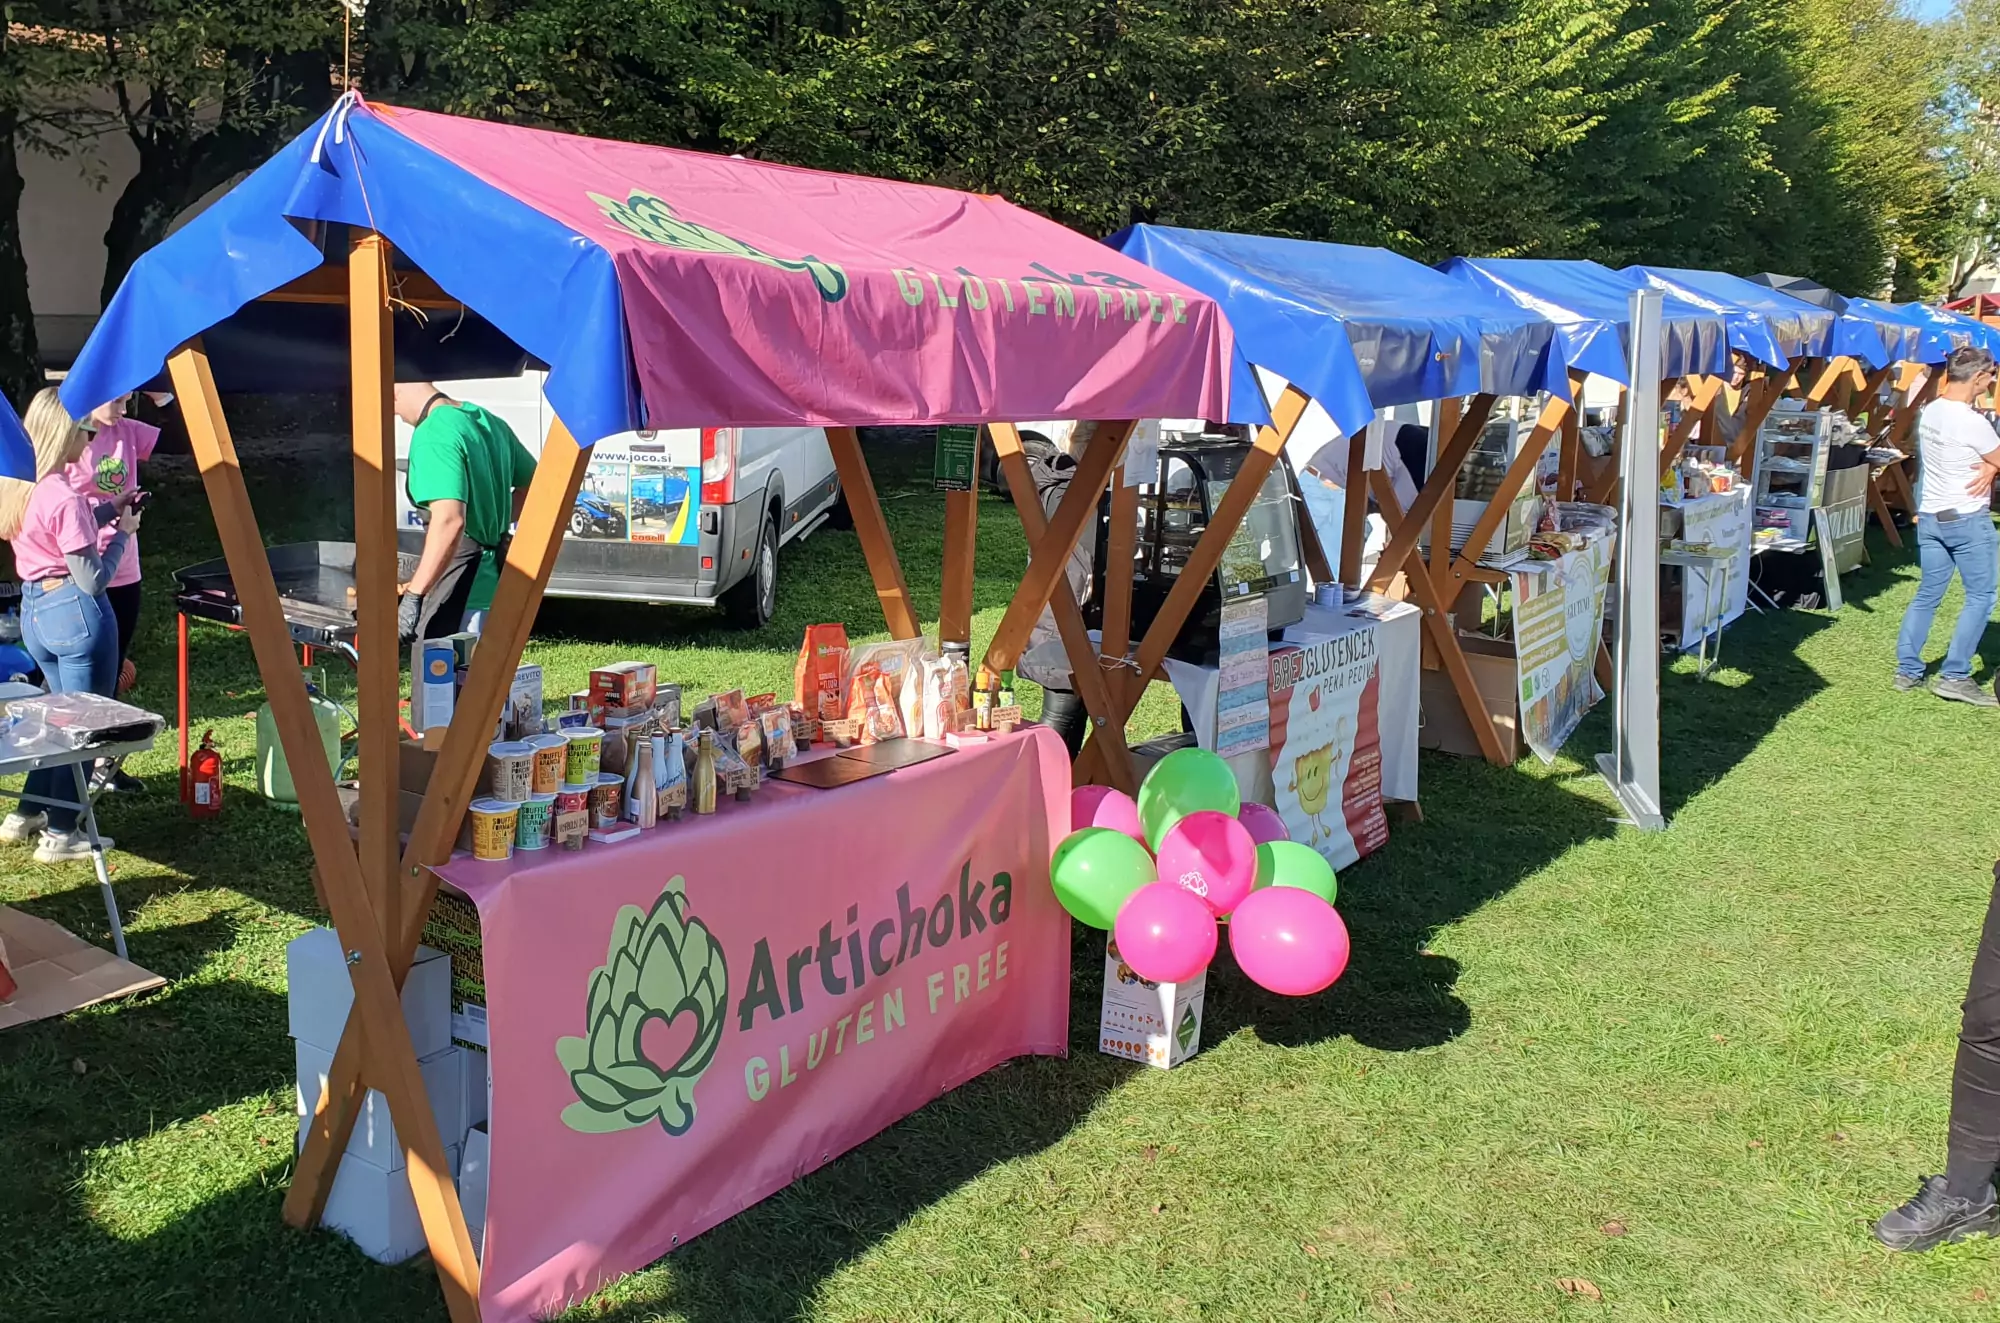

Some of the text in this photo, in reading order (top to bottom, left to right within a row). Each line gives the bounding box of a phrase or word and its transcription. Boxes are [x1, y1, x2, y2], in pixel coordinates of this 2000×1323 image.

[890, 268, 1076, 319] GLUTEN
[1091, 286, 1188, 325] FREE
[593, 452, 672, 463] www.joco.si
[1322, 672, 1345, 696] PEKA
[737, 857, 1013, 1033] Artichoka
[744, 940, 1010, 1103] GLUTEN FREE
